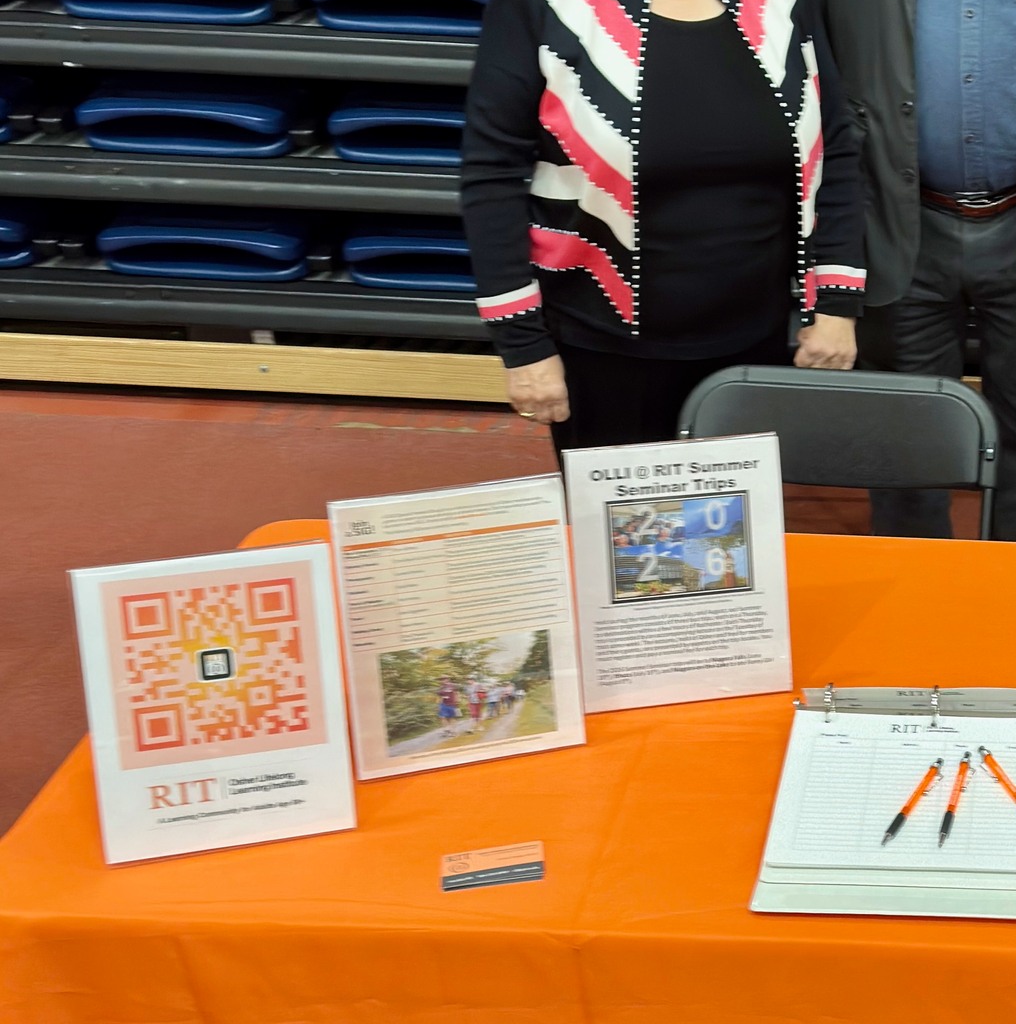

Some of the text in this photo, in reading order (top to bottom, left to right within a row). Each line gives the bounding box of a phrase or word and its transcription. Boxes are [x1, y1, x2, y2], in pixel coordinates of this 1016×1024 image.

[589, 459, 760, 482] OLLI @ RIT Summer
[615, 478, 737, 497] Seminar Trips
[634, 501, 727, 536] 2 0
[636, 548, 727, 582] 2 6
[891, 724, 921, 733] RIT
[146, 778, 217, 810] RIT
